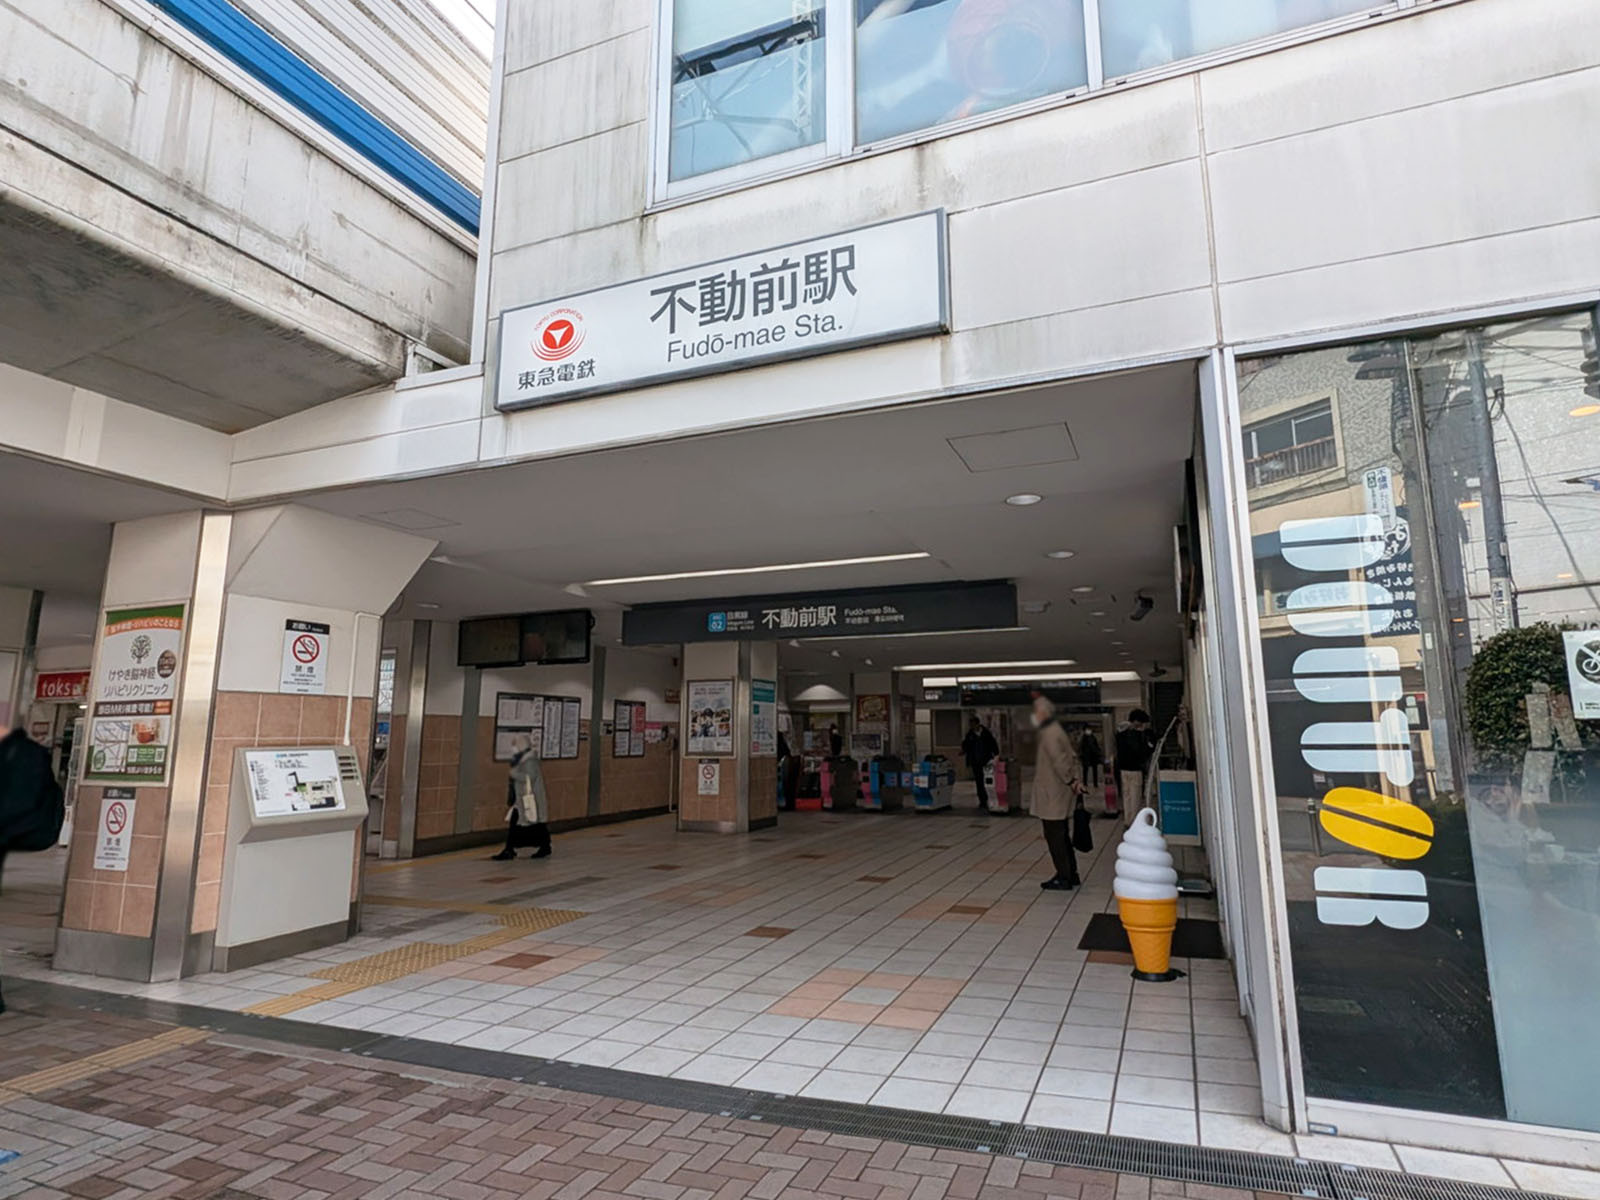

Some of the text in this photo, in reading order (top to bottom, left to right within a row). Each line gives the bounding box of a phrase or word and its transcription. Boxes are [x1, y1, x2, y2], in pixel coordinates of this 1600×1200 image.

[649, 244, 858, 335] 不動前駅
[667, 314, 843, 362] Fudō-mae Sta.
[518, 358, 596, 391] 東急電鉄
[761, 605, 837, 630] 不動前駅
[41, 678, 70, 697] toks
[108, 667, 156, 681] けやき脳神経
[104, 684, 169, 697] リハビリクリニック
[1278, 513, 1435, 930] DOUTOR
